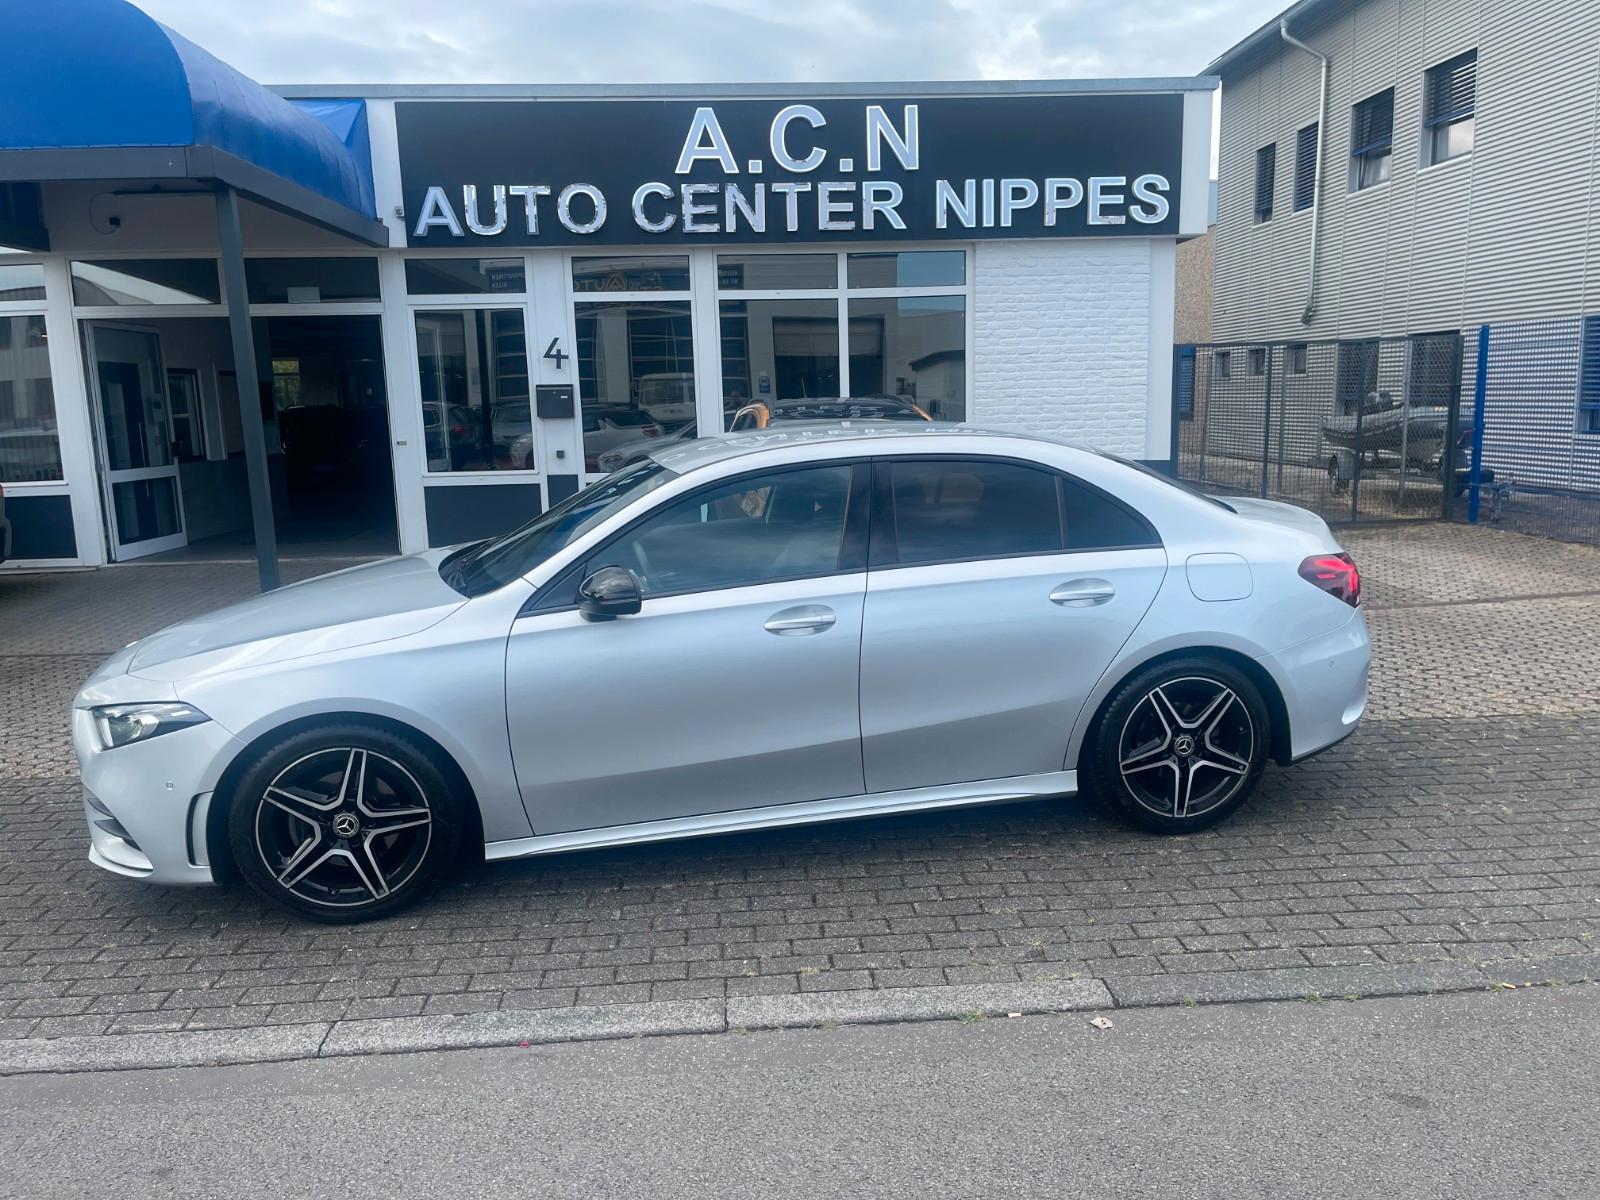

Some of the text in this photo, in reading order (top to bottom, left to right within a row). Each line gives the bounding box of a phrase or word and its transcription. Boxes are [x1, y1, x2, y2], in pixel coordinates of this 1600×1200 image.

[675, 104, 919, 174] A.C.N
[413, 173, 1170, 237] AUTO CENTER NIPPES
[543, 337, 569, 369] 4
